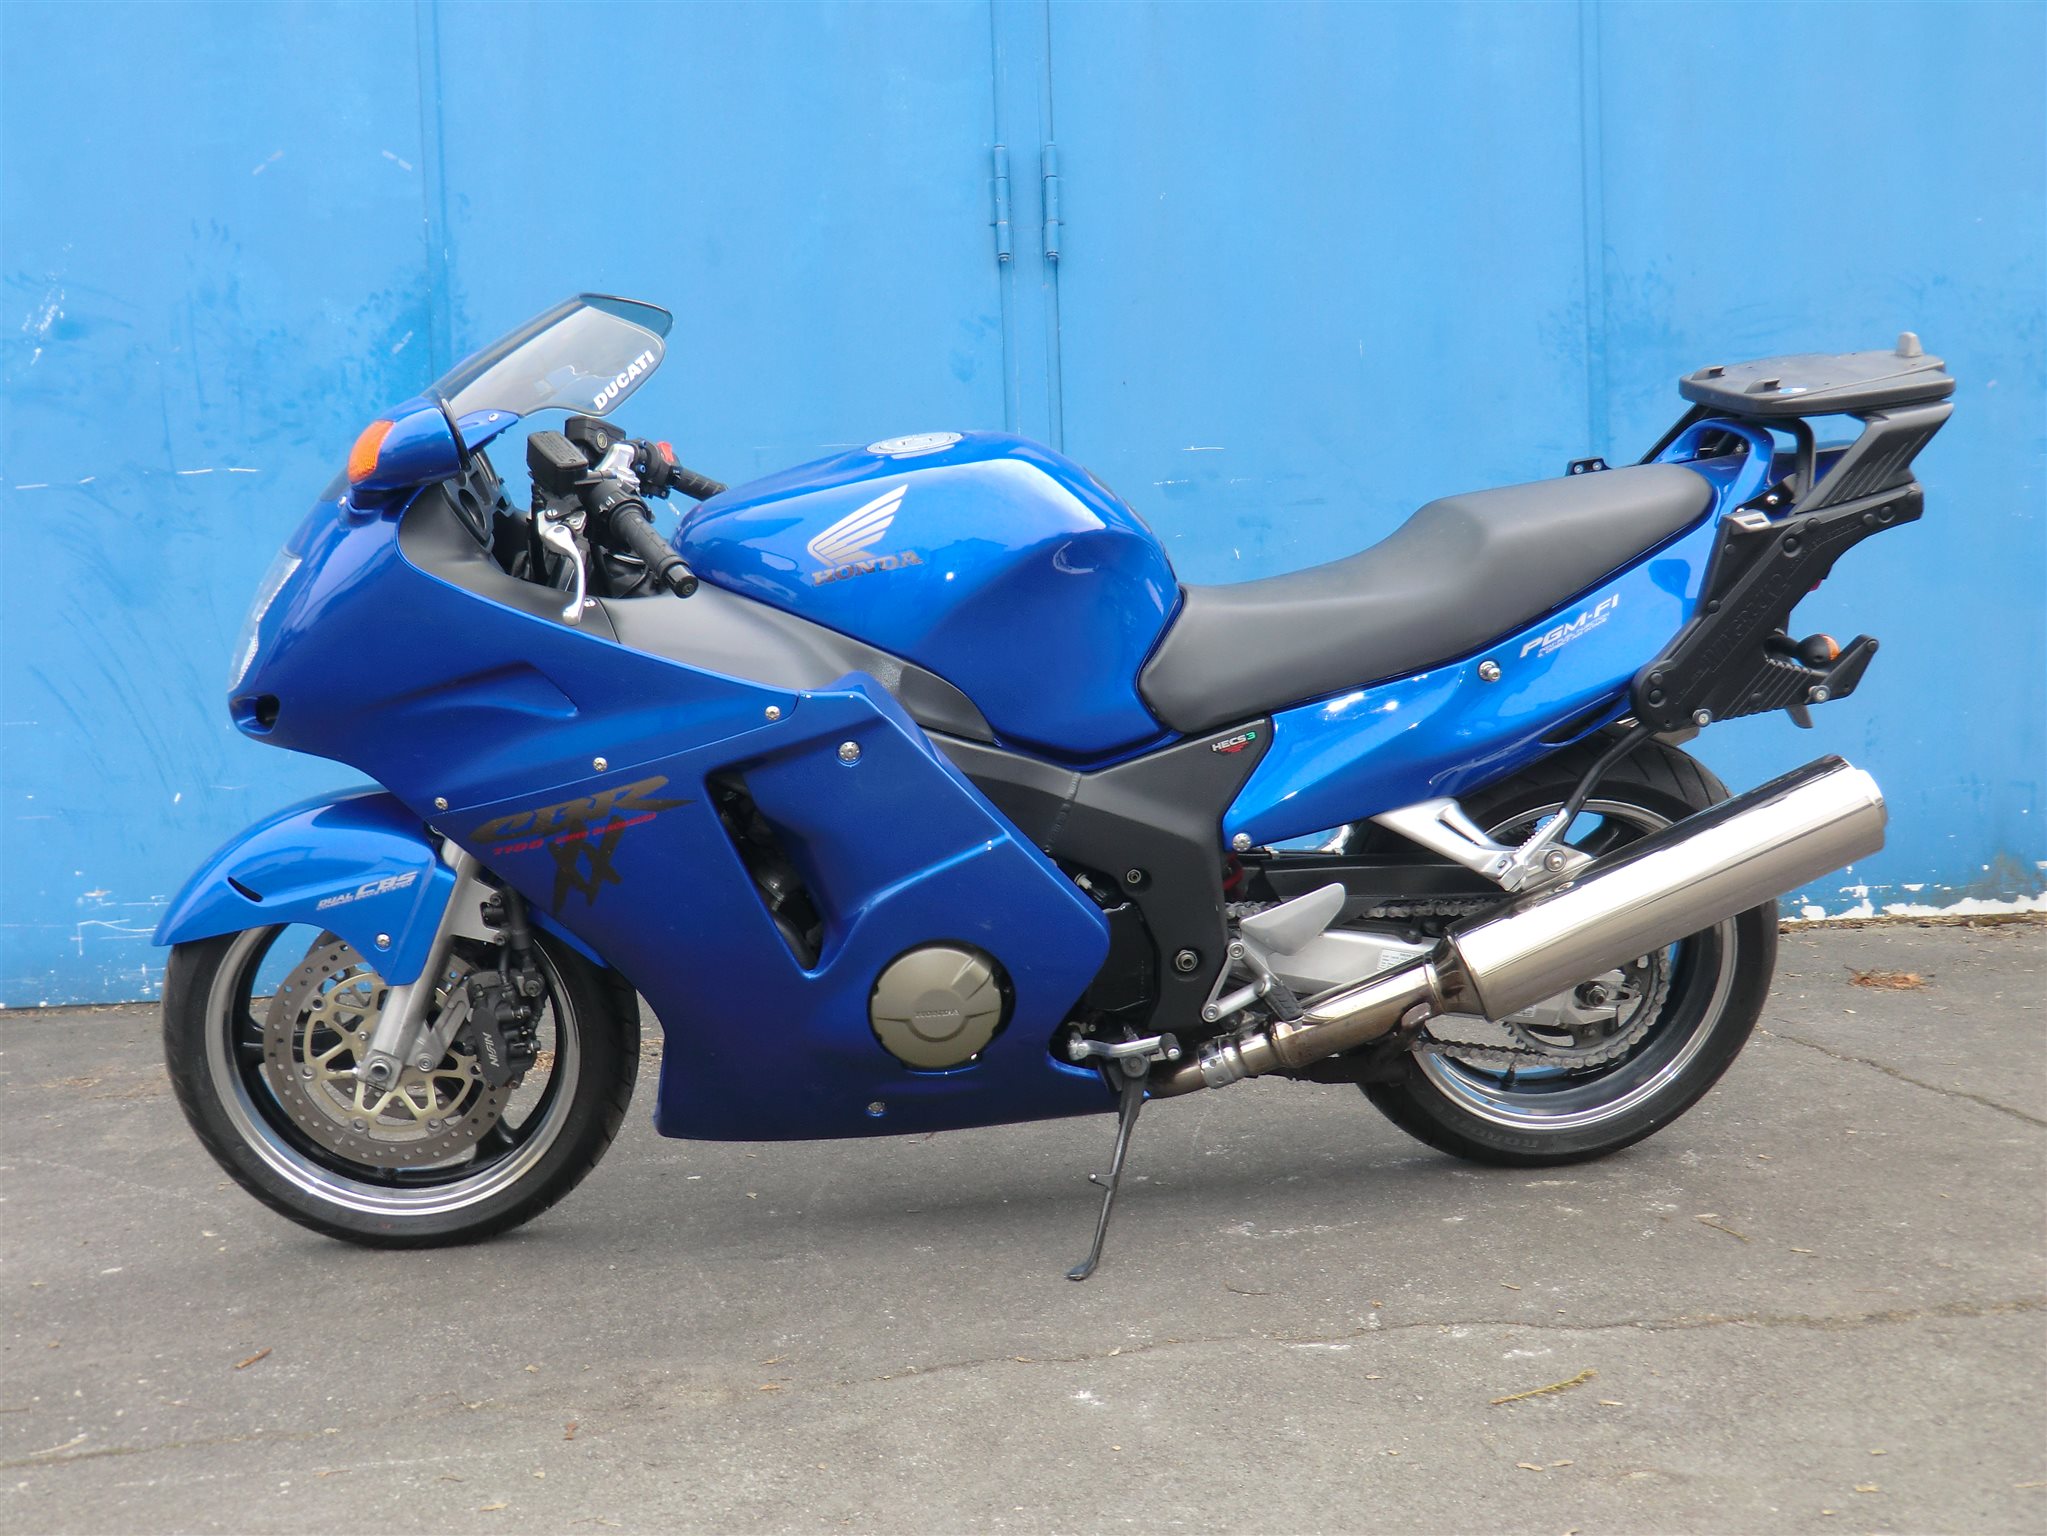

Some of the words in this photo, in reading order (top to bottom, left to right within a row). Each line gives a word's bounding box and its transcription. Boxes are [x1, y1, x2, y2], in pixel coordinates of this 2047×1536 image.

[594, 351, 655, 410] DUCATI
[812, 550, 923, 587] HONDA
[1520, 593, 1619, 658] PGM-FI
[469, 775, 697, 843] CBR
[494, 839, 544, 855] 1100
[317, 892, 354, 909] DUAL
[355, 870, 418, 898] CBS
